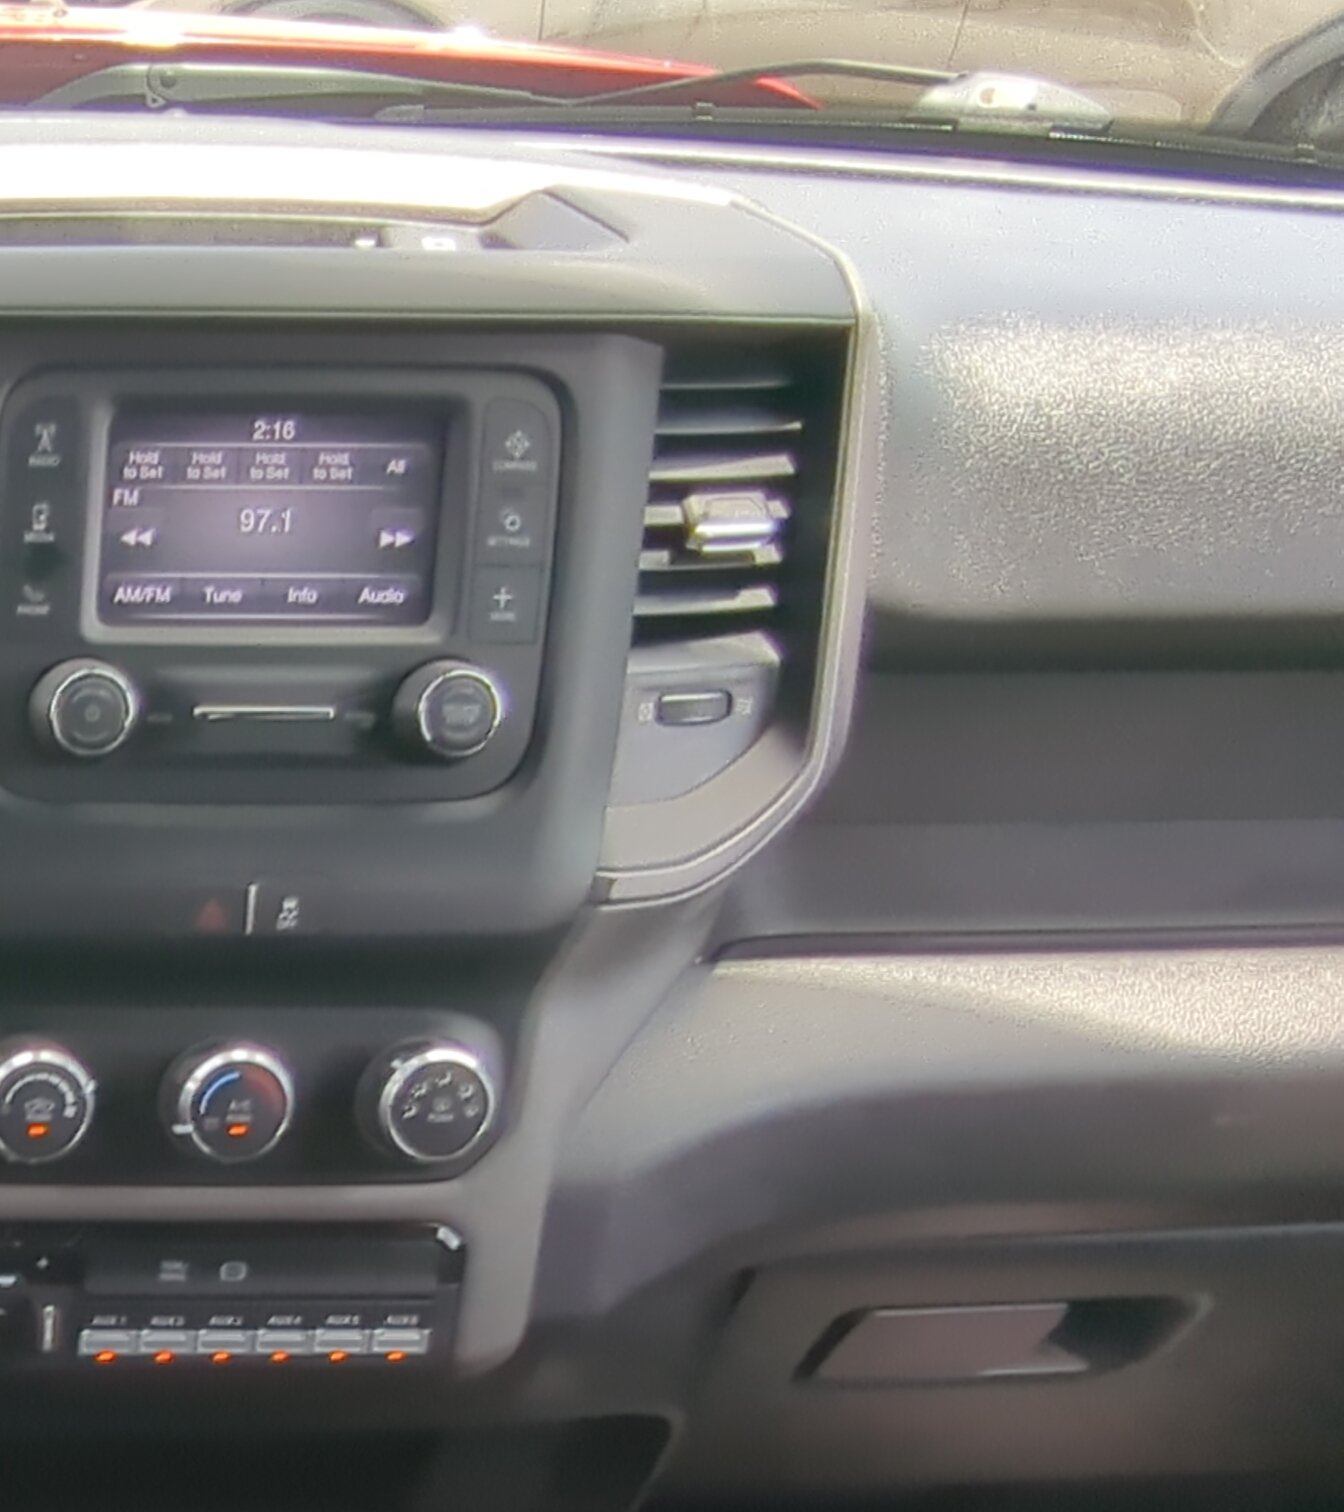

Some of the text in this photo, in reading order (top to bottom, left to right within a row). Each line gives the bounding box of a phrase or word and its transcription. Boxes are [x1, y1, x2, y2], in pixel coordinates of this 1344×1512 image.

[252, 420, 295, 440] 2:16
[129, 451, 160, 464] Hold
[192, 451, 223, 464] Hold
[255, 451, 286, 464] Hold
[319, 451, 349, 464] Hold
[123, 465, 163, 479] to Set
[187, 465, 226, 479] to Set
[250, 465, 289, 479] to Set
[313, 465, 352, 479] to Set
[113, 489, 139, 506] FM
[239, 509, 293, 533] 97.1
[114, 587, 172, 603] AM/FM
[204, 588, 242, 603] Tune
[288, 588, 318, 603] Info
[358, 588, 405, 603] Audio
